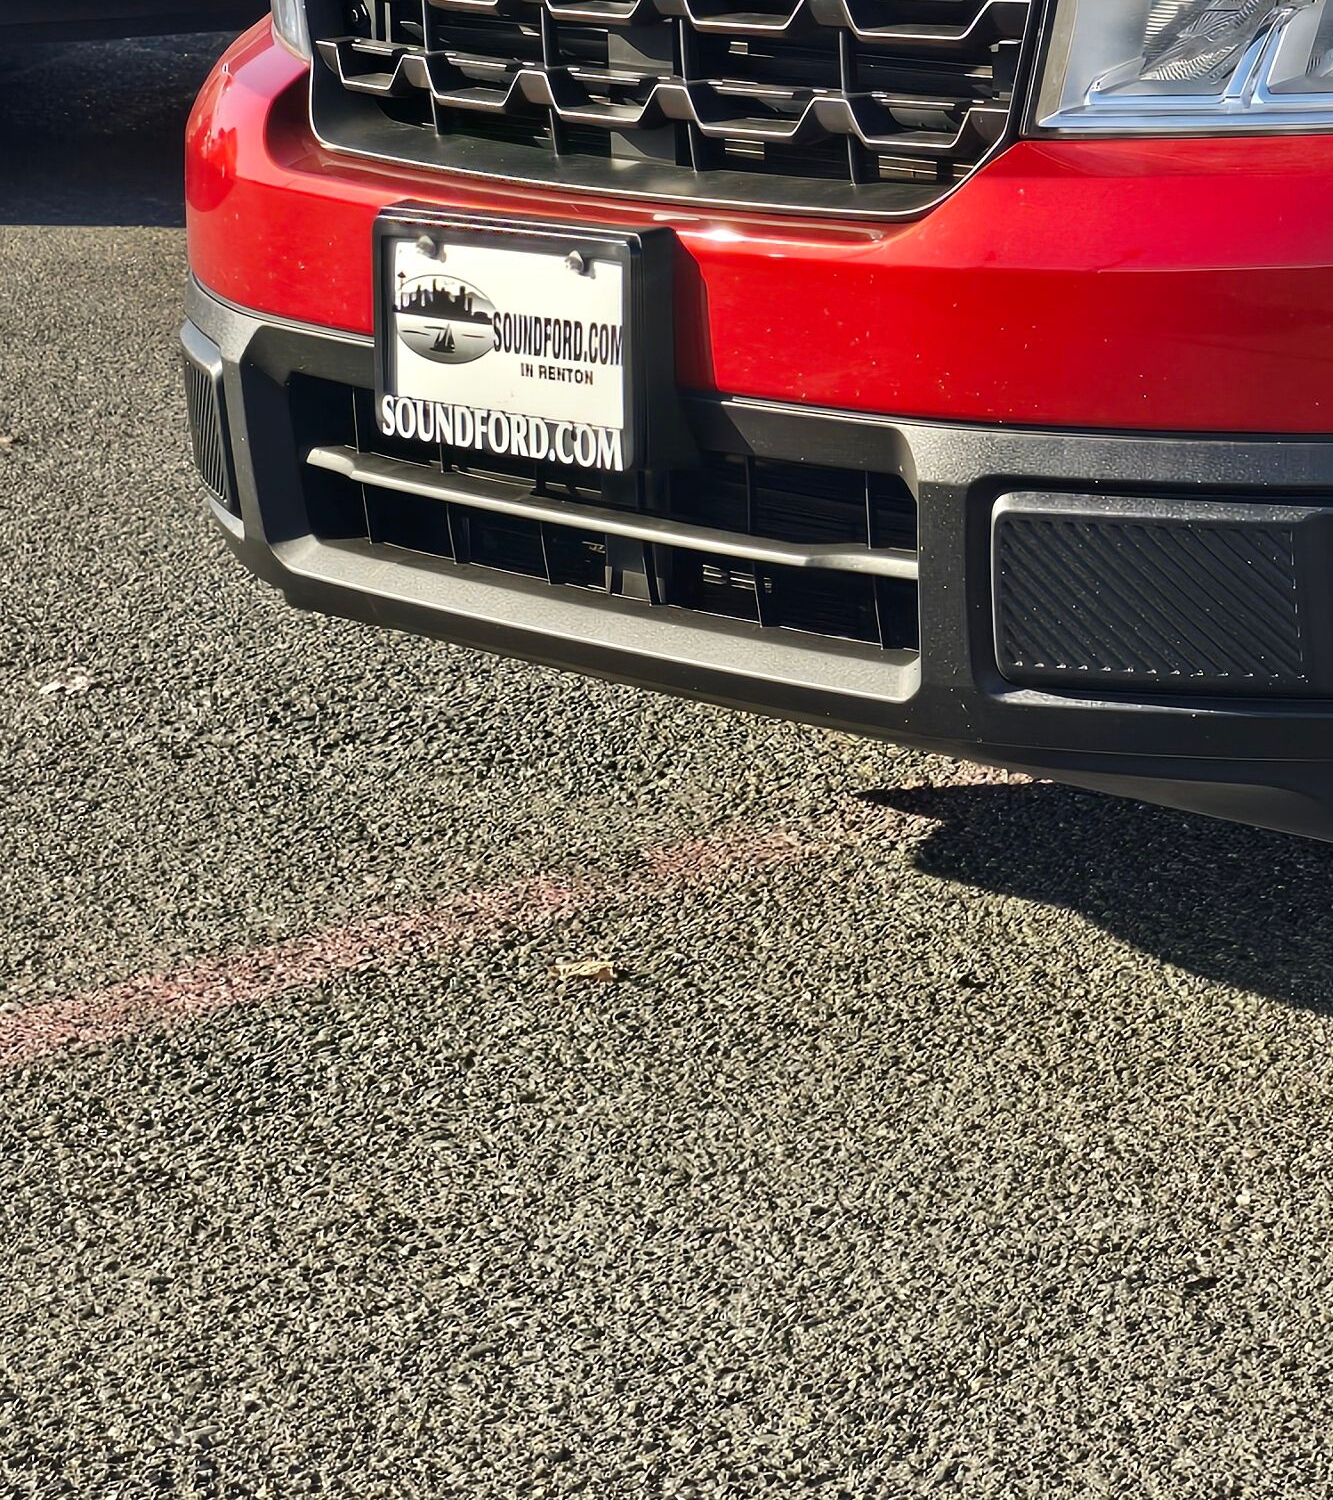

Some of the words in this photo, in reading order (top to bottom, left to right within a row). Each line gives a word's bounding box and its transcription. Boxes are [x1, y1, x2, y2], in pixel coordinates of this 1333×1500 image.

[492, 311, 623, 366] SOUNDFORD.COM
[520, 362, 534, 378] IN
[538, 365, 594, 385] RENTON
[381, 394, 624, 472] SOUNDFORD.COM
